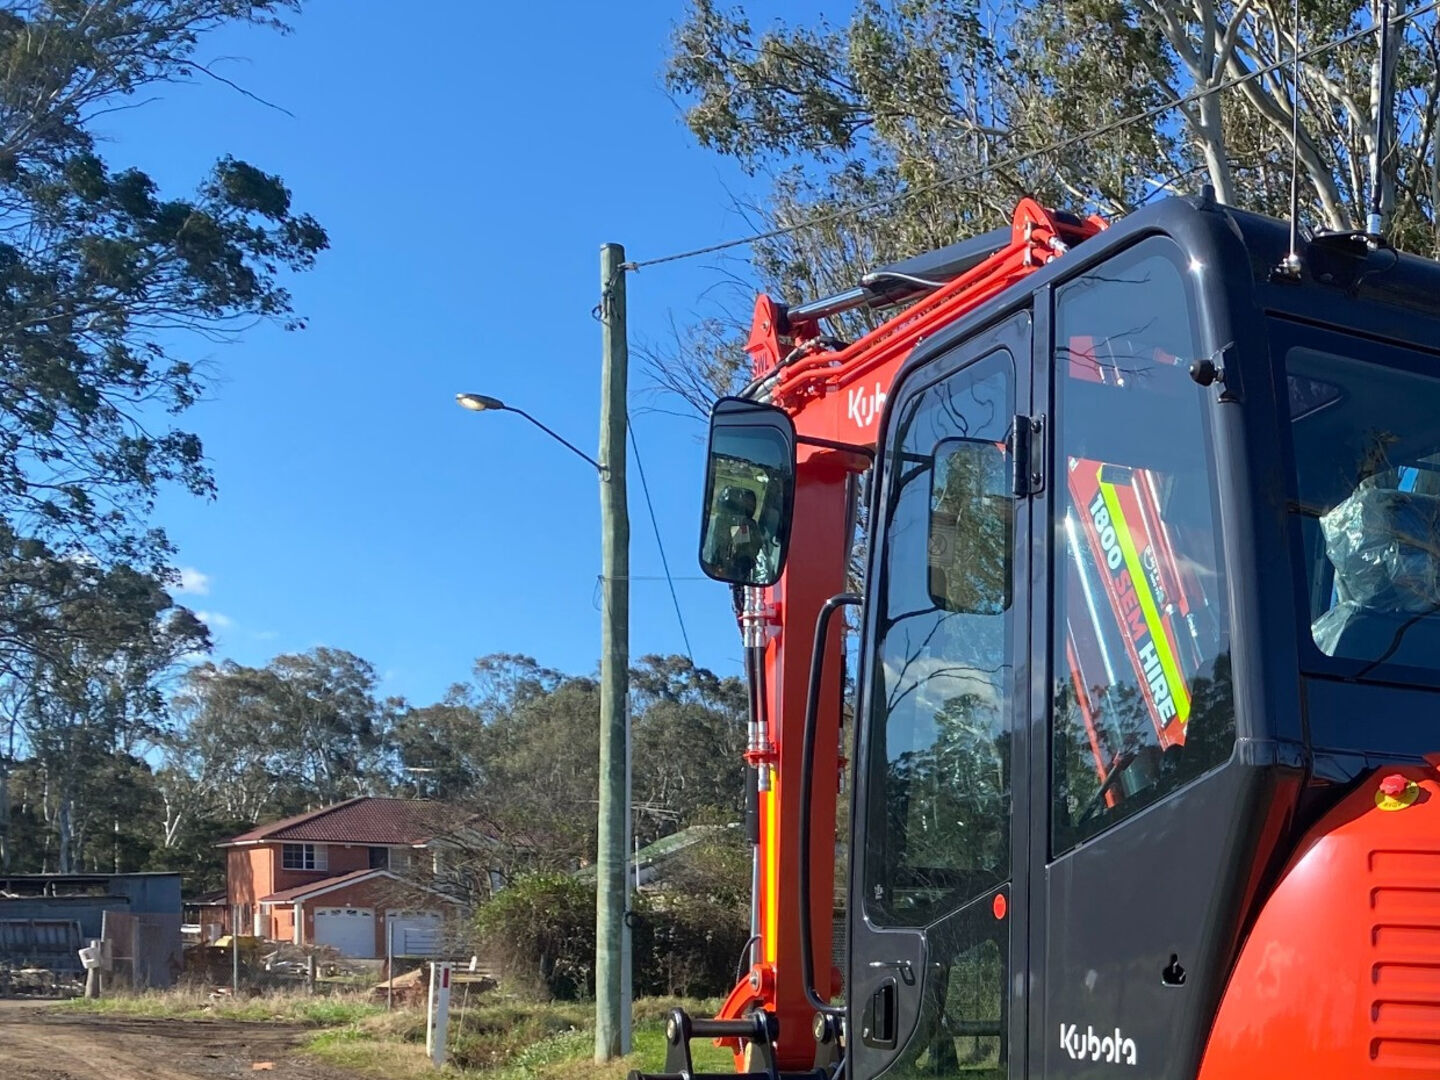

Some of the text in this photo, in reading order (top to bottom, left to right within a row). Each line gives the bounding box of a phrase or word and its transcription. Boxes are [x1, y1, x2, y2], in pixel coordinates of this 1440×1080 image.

[1089, 493, 1123, 570] 1800
[1115, 569, 1149, 642] SEM
[1138, 641, 1177, 725] HIRE
[1060, 1023, 1137, 1065] Kubota
